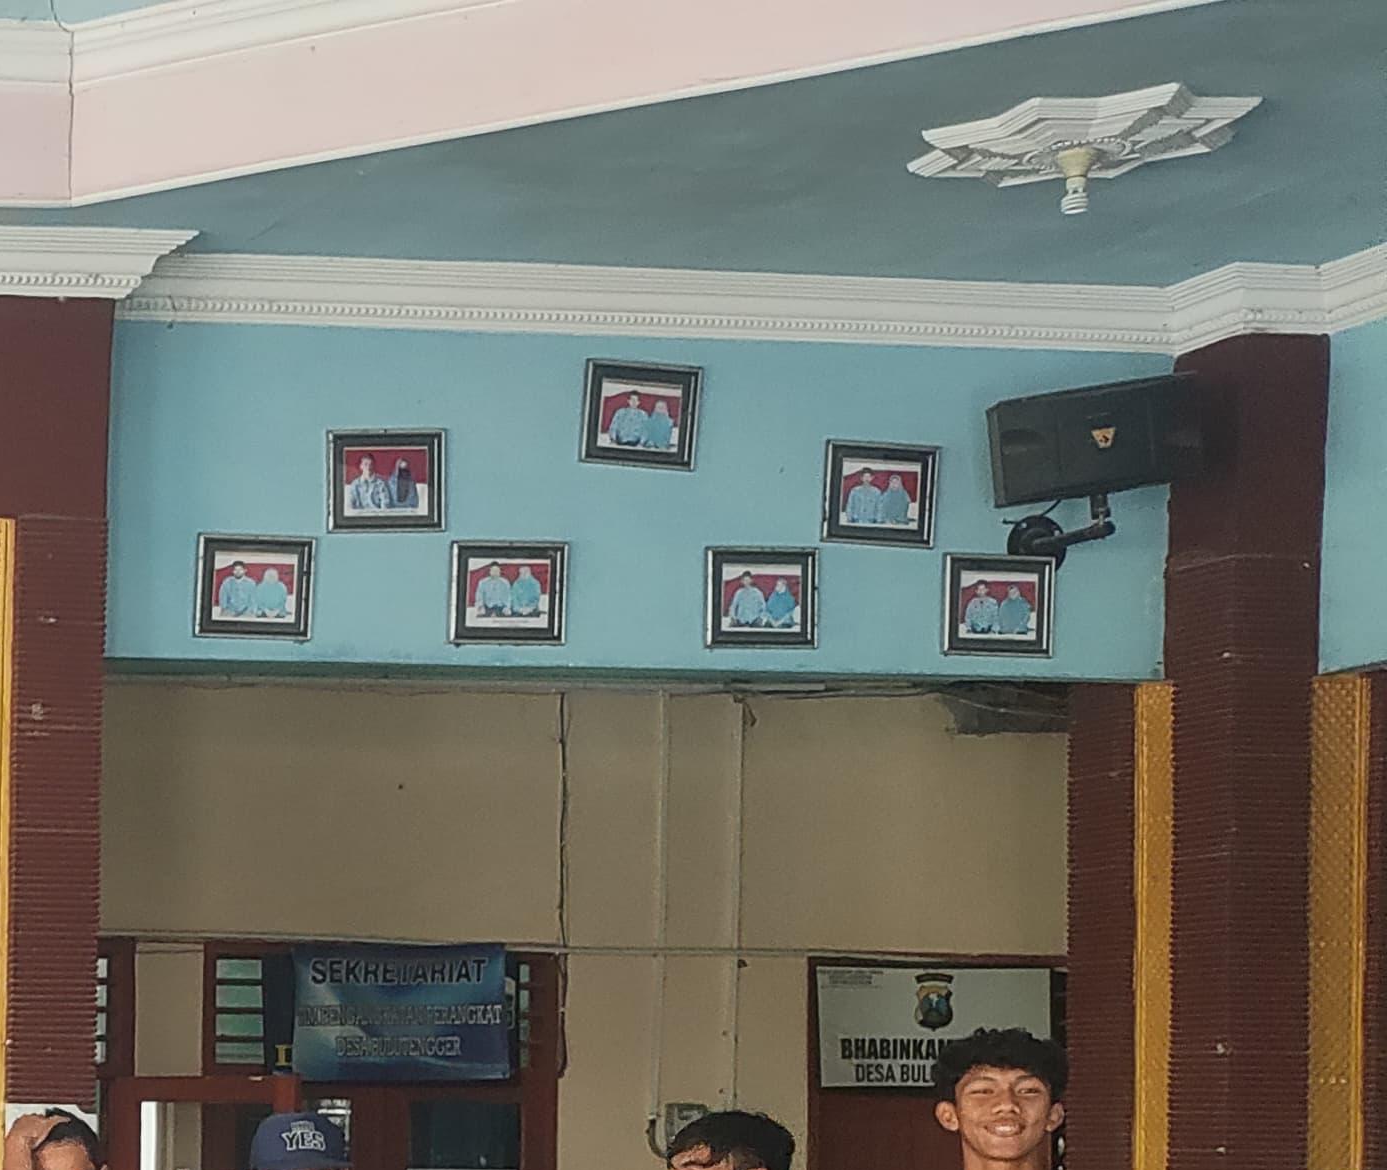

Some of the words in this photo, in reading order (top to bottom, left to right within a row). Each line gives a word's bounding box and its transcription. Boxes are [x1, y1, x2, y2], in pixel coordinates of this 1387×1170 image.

[309, 958, 489, 986] SEKRETARIAT
[855, 1063, 895, 1083] DESA
[281, 1130, 327, 1151] YES
